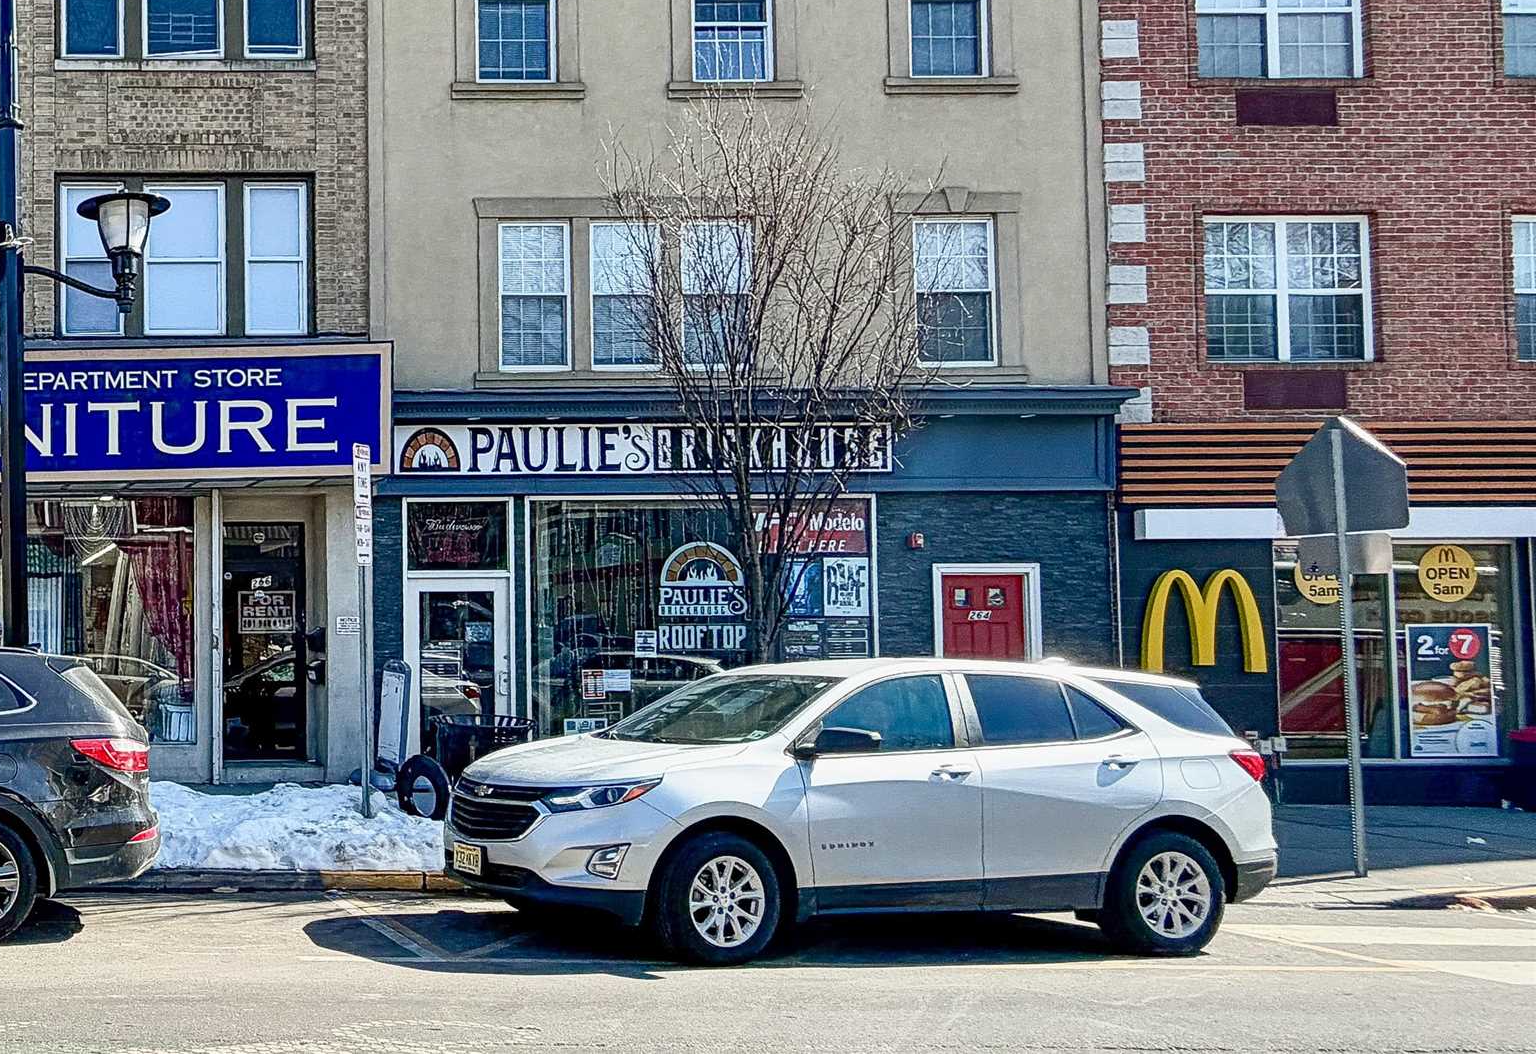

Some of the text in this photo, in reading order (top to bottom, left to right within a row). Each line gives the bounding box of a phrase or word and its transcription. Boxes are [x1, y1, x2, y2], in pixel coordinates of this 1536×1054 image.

[194, 368, 282, 388] STORE
[467, 424, 652, 473] PAULIE'S
[809, 512, 865, 531] Modelo
[1425, 567, 1470, 580] OPEN
[1309, 584, 1340, 596] 5am
[1432, 584, 1464, 596] 5am
[249, 595, 284, 605] FOR
[659, 587, 748, 615] PAULIE'S
[243, 606, 291, 617] RENT
[658, 625, 747, 649] ROOFTOP
[1417, 634, 1434, 655] 2
[1434, 645, 1449, 655] for
